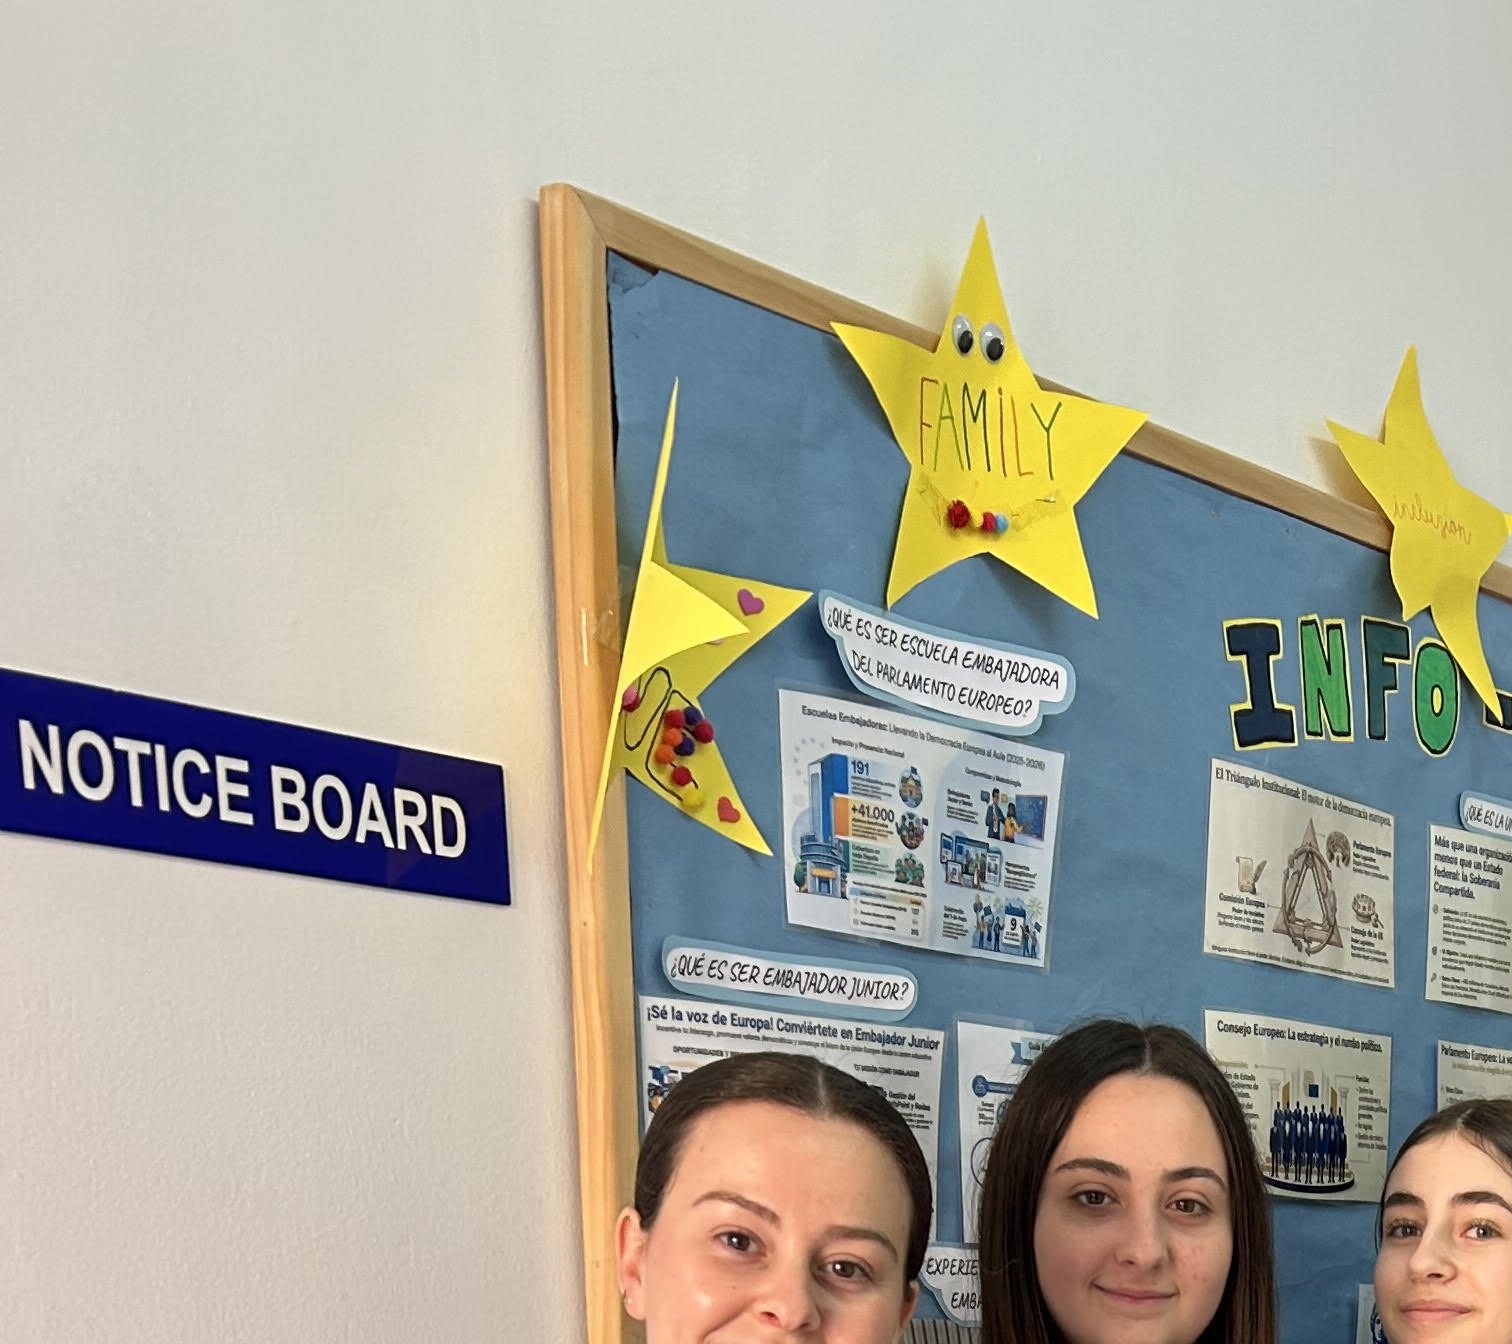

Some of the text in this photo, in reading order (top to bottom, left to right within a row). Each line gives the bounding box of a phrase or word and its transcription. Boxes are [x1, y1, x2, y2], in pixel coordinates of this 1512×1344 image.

[919, 376, 1063, 481] FAMILY
[856, 618, 871, 640] ES
[875, 624, 897, 648] SER
[900, 634, 959, 665] ESCUELA
[961, 650, 1060, 690] EMBAJADORA
[851, 649, 1033, 717] DEL PARLAMENTO EUROPEO?
[801, 705, 838, 721] Escuelas
[851, 760, 869, 776] 191
[1216, 767, 1224, 780] El
[1225, 769, 1260, 788] Triángulo
[18, 718, 468, 860] NOTICE BOARD
[1484, 810, 1495, 826] ES
[1495, 812, 1504, 828] LA
[1434, 835, 1450, 848] Más
[1451, 839, 1464, 853] que
[1465, 843, 1478, 855] una
[1434, 853, 1458, 866] menos
[1459, 858, 1473, 870] que
[1010, 918, 1017, 931] 9
[670, 953, 909, 1001] ¿QUÉ ES SER EMBAJADOR JUNIOR?
[647, 1004, 940, 1050] ¡Sé la voz de Europa! Conviértete en Embajador Junior
[1217, 1019, 1251, 1037] Consejo
[1253, 1023, 1286, 1040] Europeo:
[1288, 1027, 1296, 1040] La
[926, 1257, 980, 1276] EXPERIE
